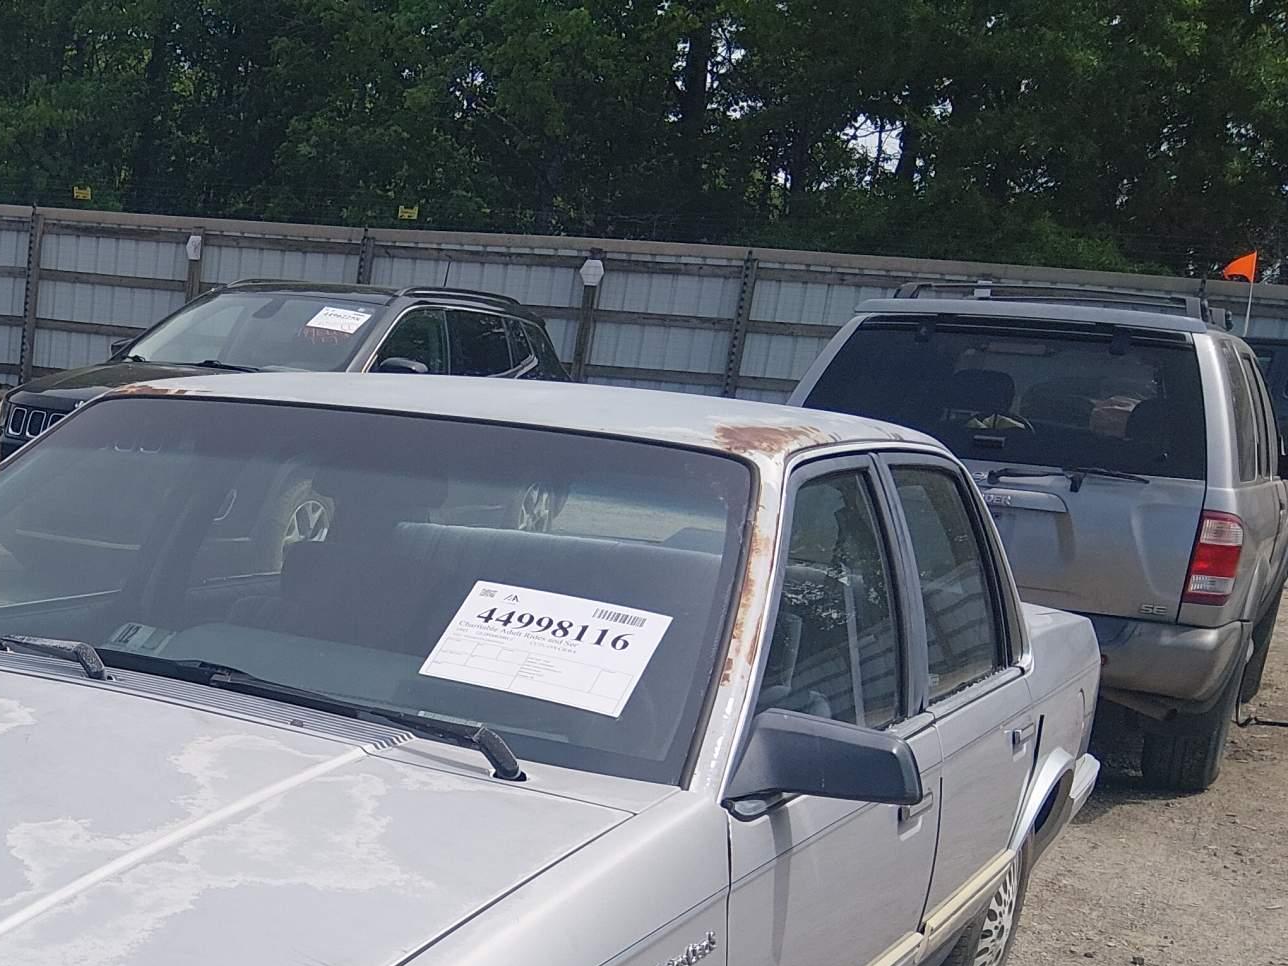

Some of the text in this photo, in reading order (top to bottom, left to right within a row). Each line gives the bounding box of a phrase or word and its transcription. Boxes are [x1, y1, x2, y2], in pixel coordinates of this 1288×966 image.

[1140, 604, 1168, 615] SE
[476, 607, 634, 651] 44998116
[501, 628, 522, 637] Adult
[523, 632, 546, 642] Rides
[548, 637, 562, 645] and
